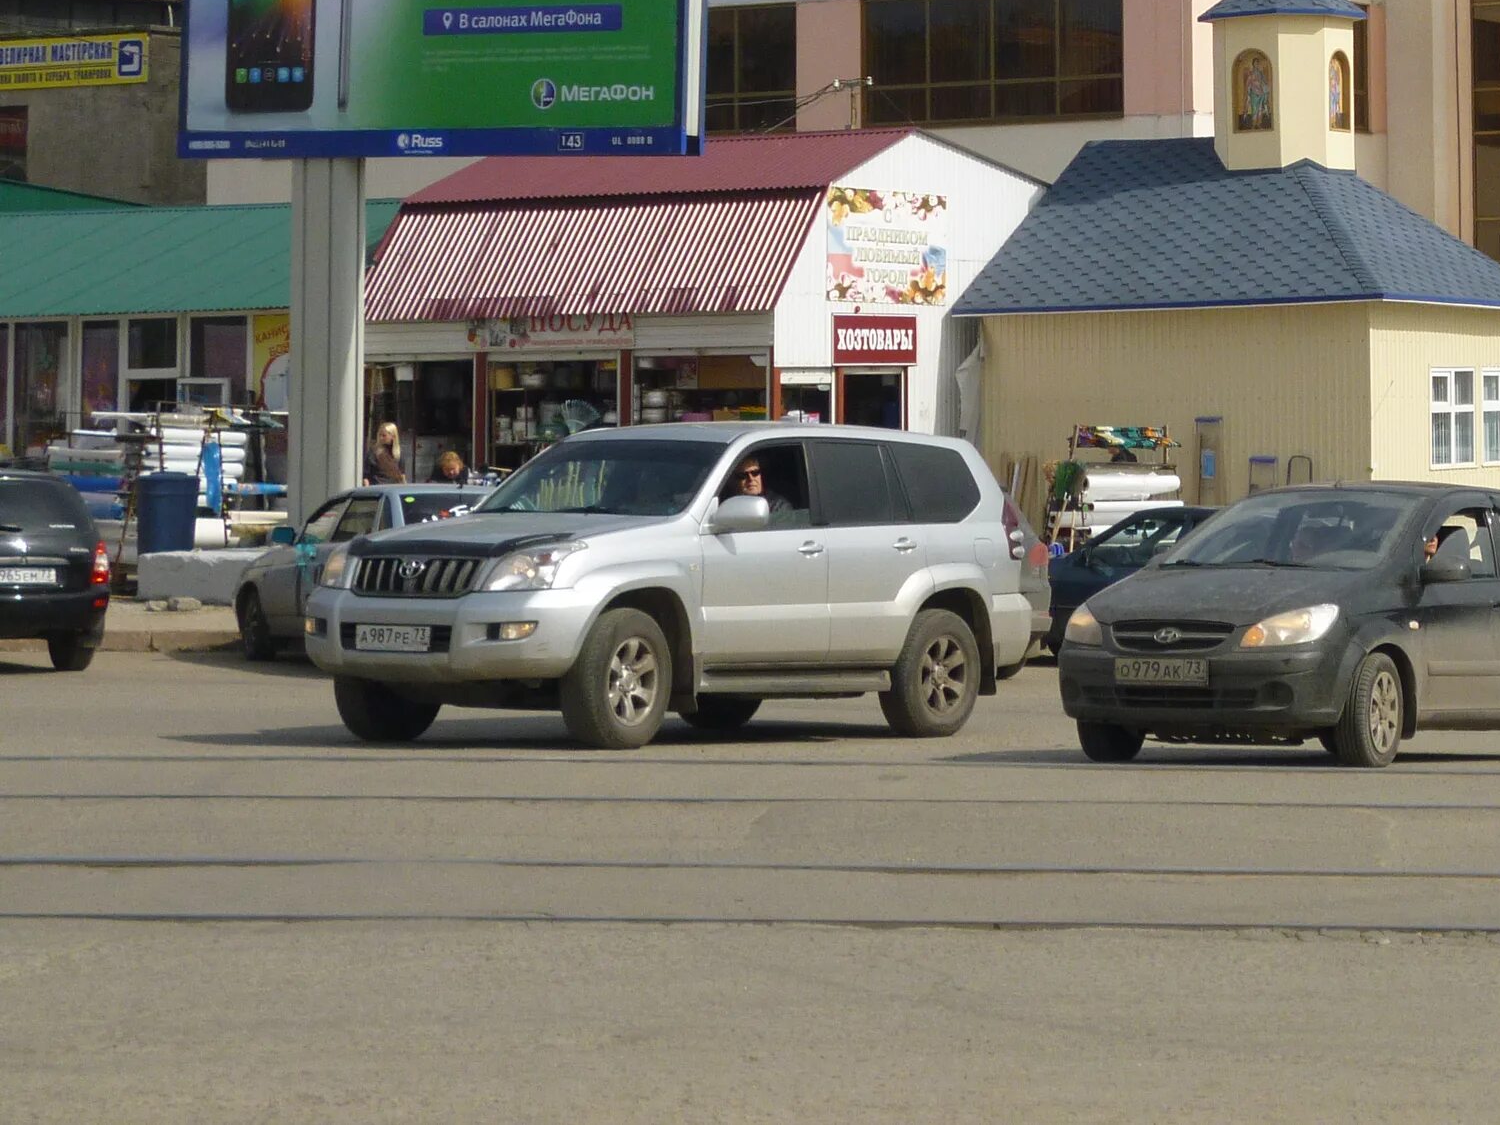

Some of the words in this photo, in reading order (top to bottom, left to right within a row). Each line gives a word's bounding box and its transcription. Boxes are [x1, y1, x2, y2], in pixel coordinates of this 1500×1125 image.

[459, 13, 469, 29] В
[471, 15, 528, 29] салонах
[411, 133, 443, 148] Russ
[561, 135, 582, 148] 143
[846, 226, 928, 247] ПРАЗДНИКОМ
[854, 247, 921, 266] ЛЮБИМЫЙ
[529, 312, 633, 335] ПОСУДА
[836, 328, 914, 351] ХОЗТОВАРЫ
